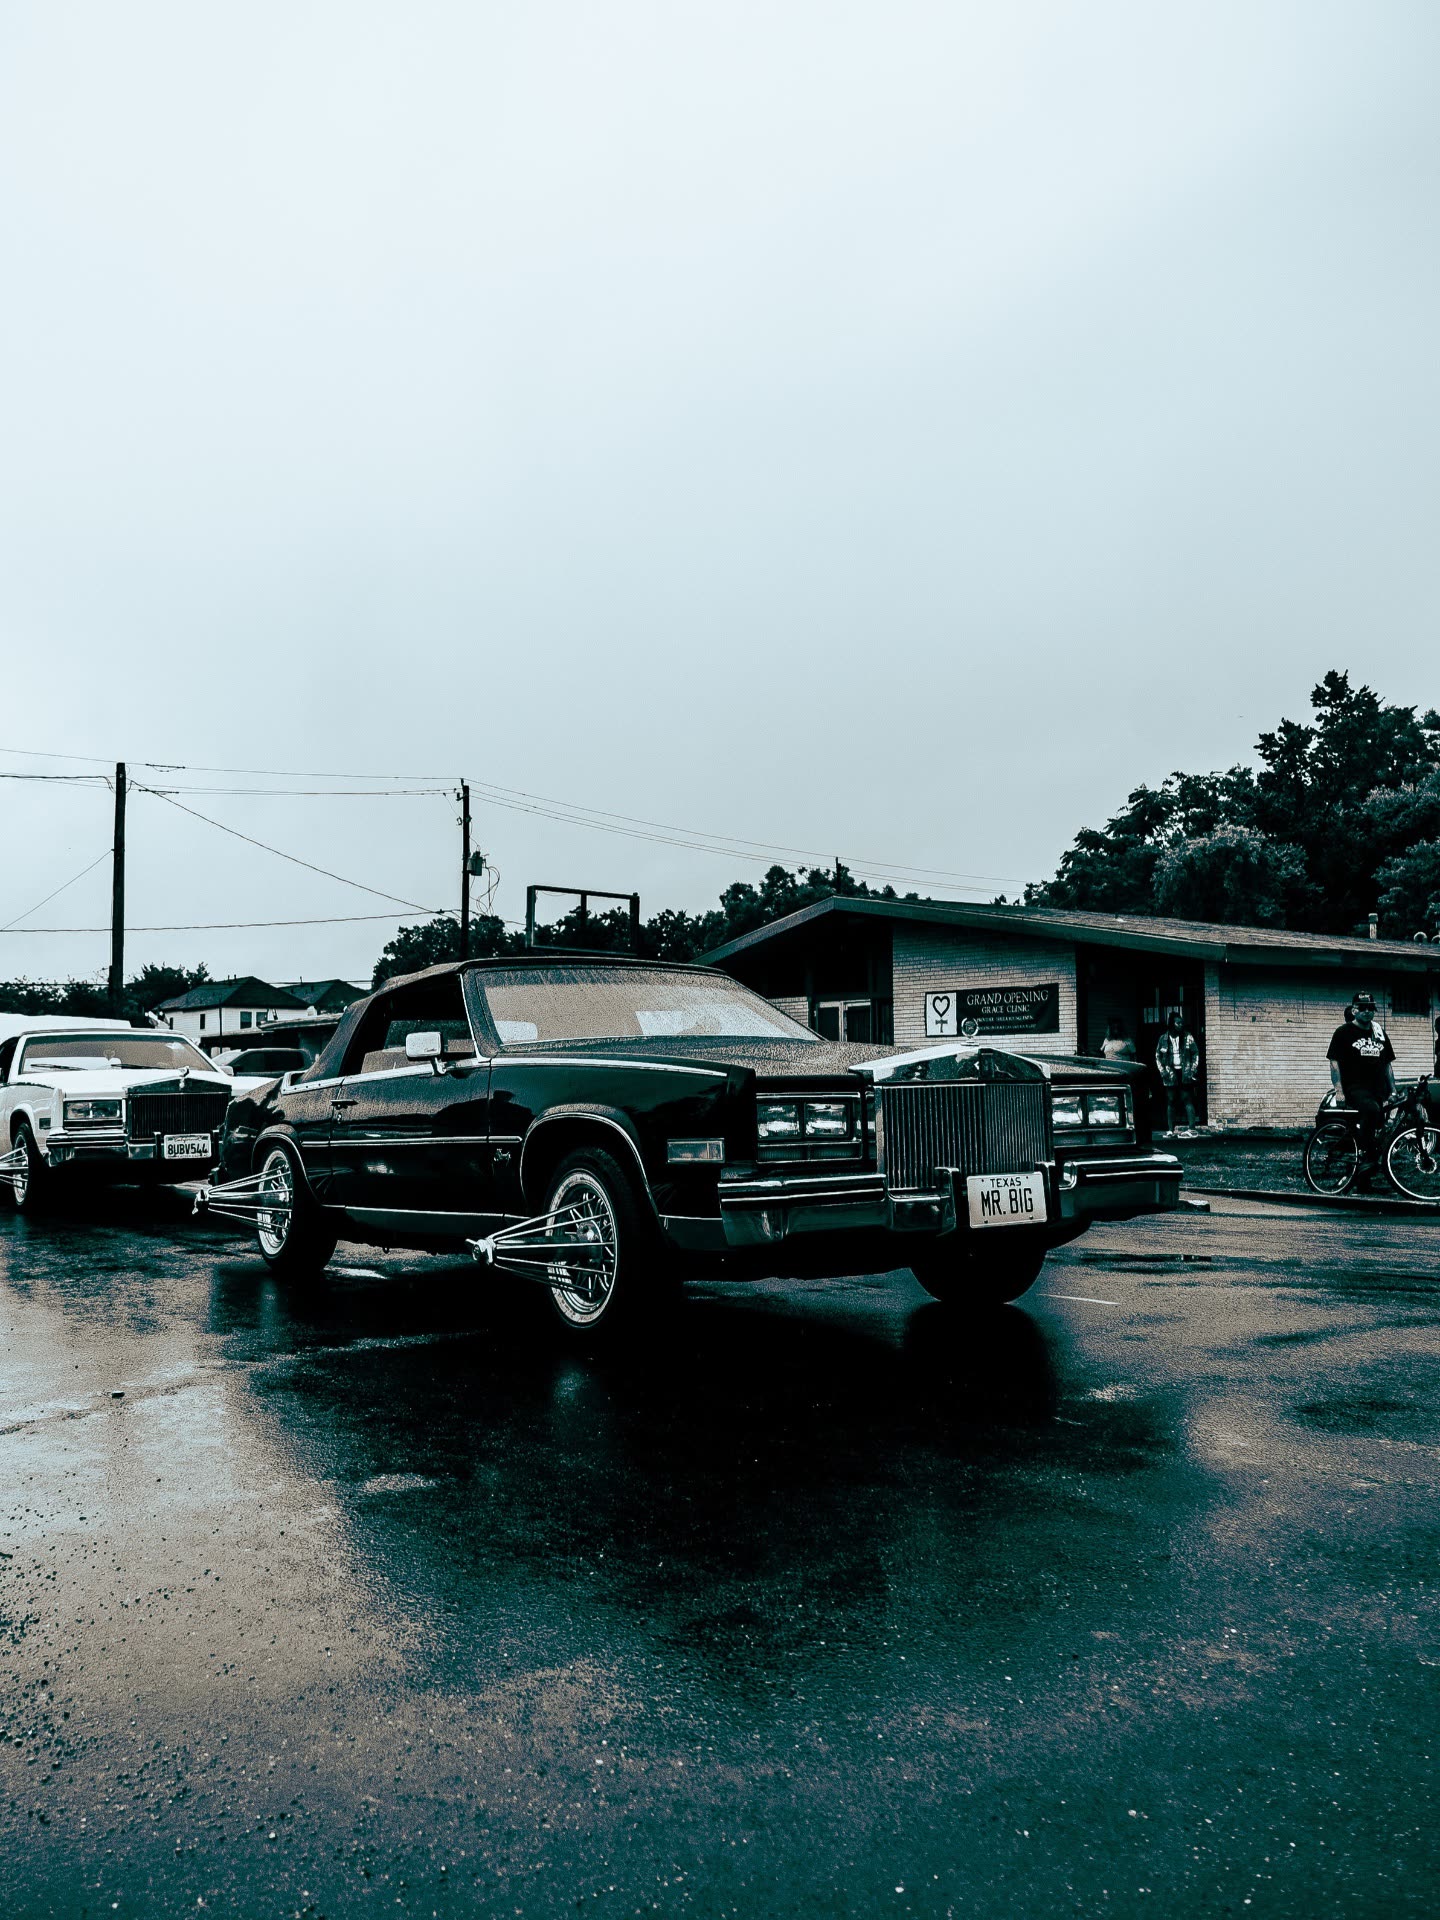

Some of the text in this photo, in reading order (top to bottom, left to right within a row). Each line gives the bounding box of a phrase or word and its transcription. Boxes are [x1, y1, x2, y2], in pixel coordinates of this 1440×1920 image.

[966, 989, 1049, 1006] GRAND OPENING
[981, 1004, 1030, 1014] GRACE CLINIC
[990, 1177, 1021, 1188] TEXAS
[981, 1188, 1034, 1216] MR. BIG
